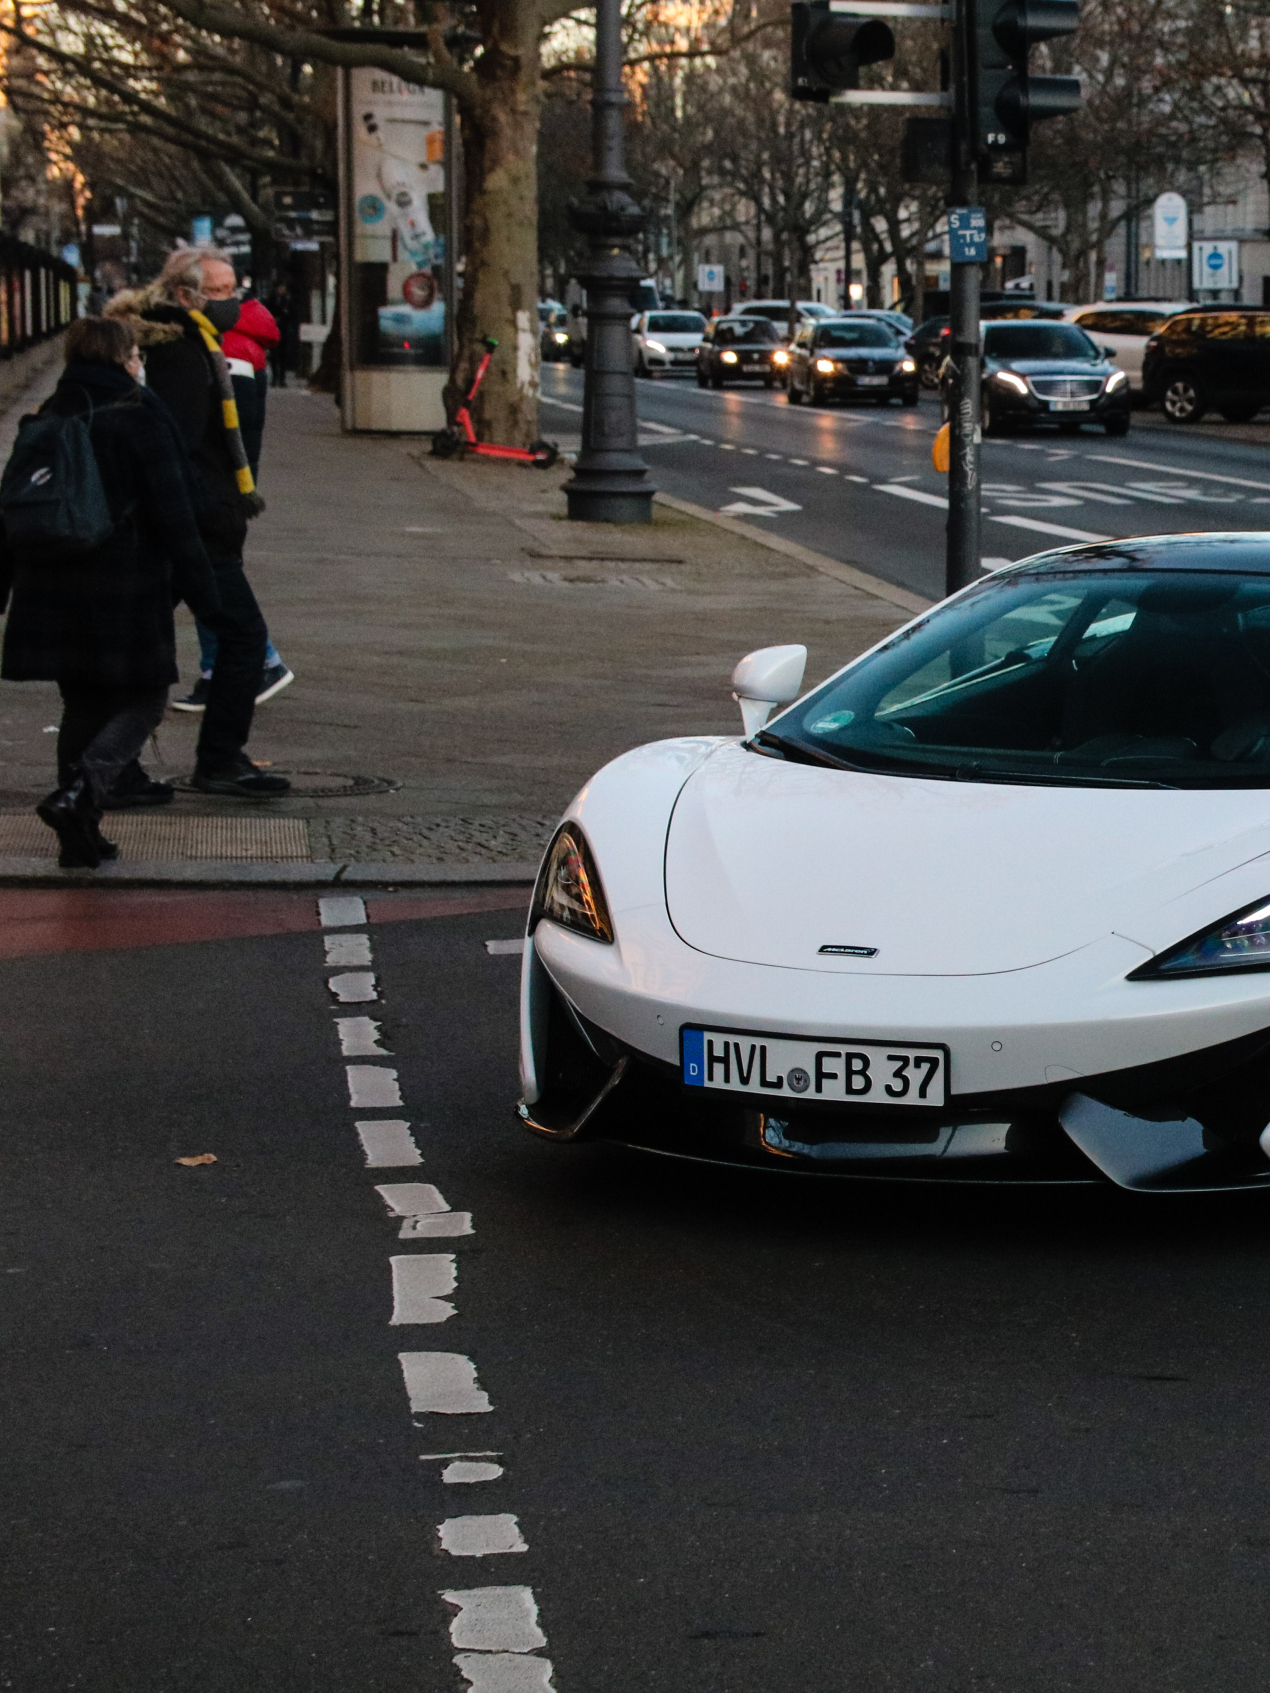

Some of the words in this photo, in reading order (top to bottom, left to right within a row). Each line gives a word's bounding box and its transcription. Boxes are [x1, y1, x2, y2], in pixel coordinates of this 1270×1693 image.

[950, 214, 960, 229] S
[706, 1039, 784, 1089] HVL
[814, 1050, 873, 1096] FB
[884, 1053, 941, 1099] 37
